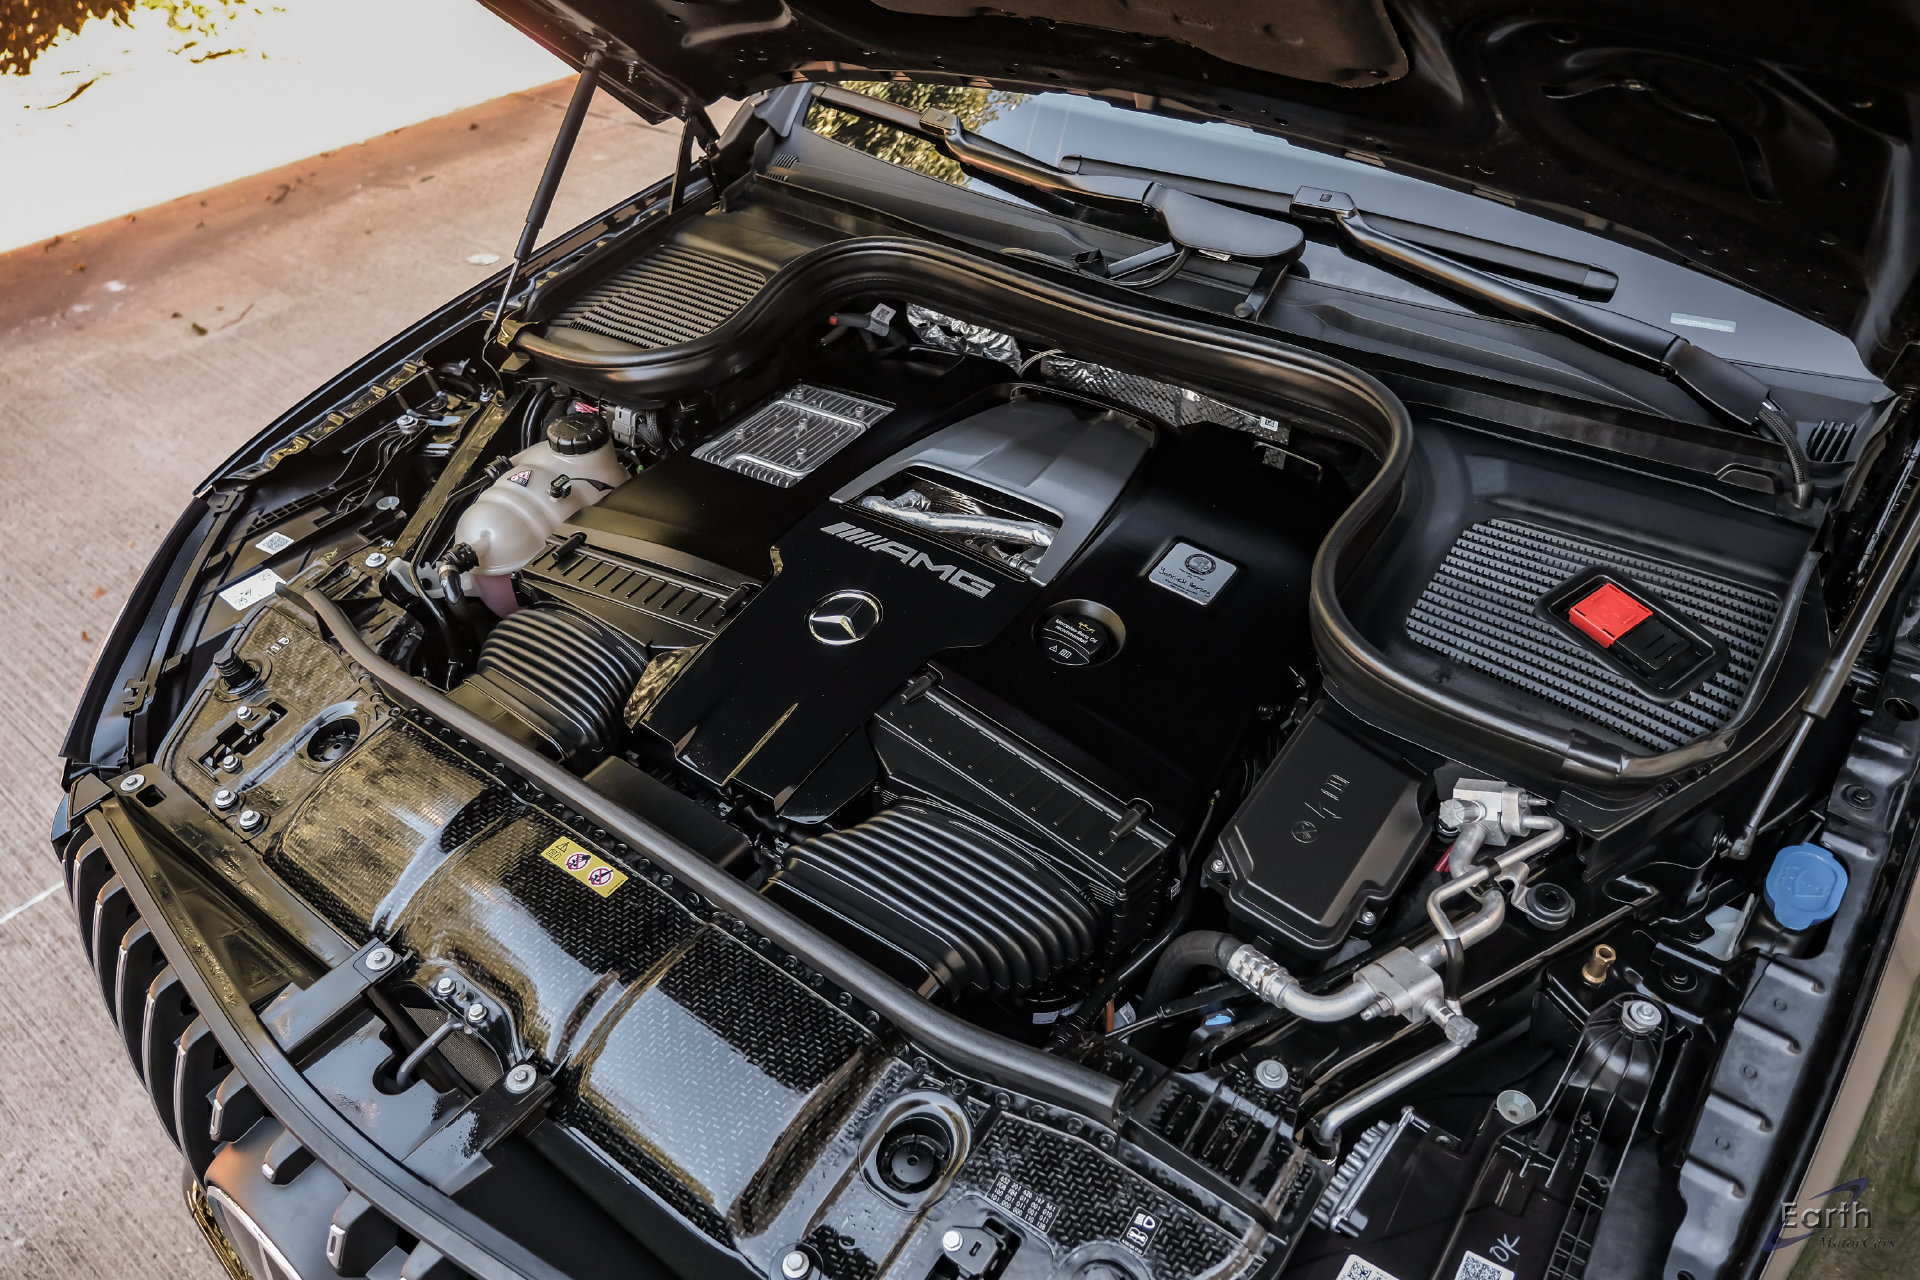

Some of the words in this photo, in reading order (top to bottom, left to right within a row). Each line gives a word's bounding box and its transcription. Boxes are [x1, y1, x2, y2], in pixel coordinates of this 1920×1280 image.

[867, 536, 996, 599] AMG
[1055, 625, 1088, 644] recommended
[1489, 1233, 1521, 1263] OK
